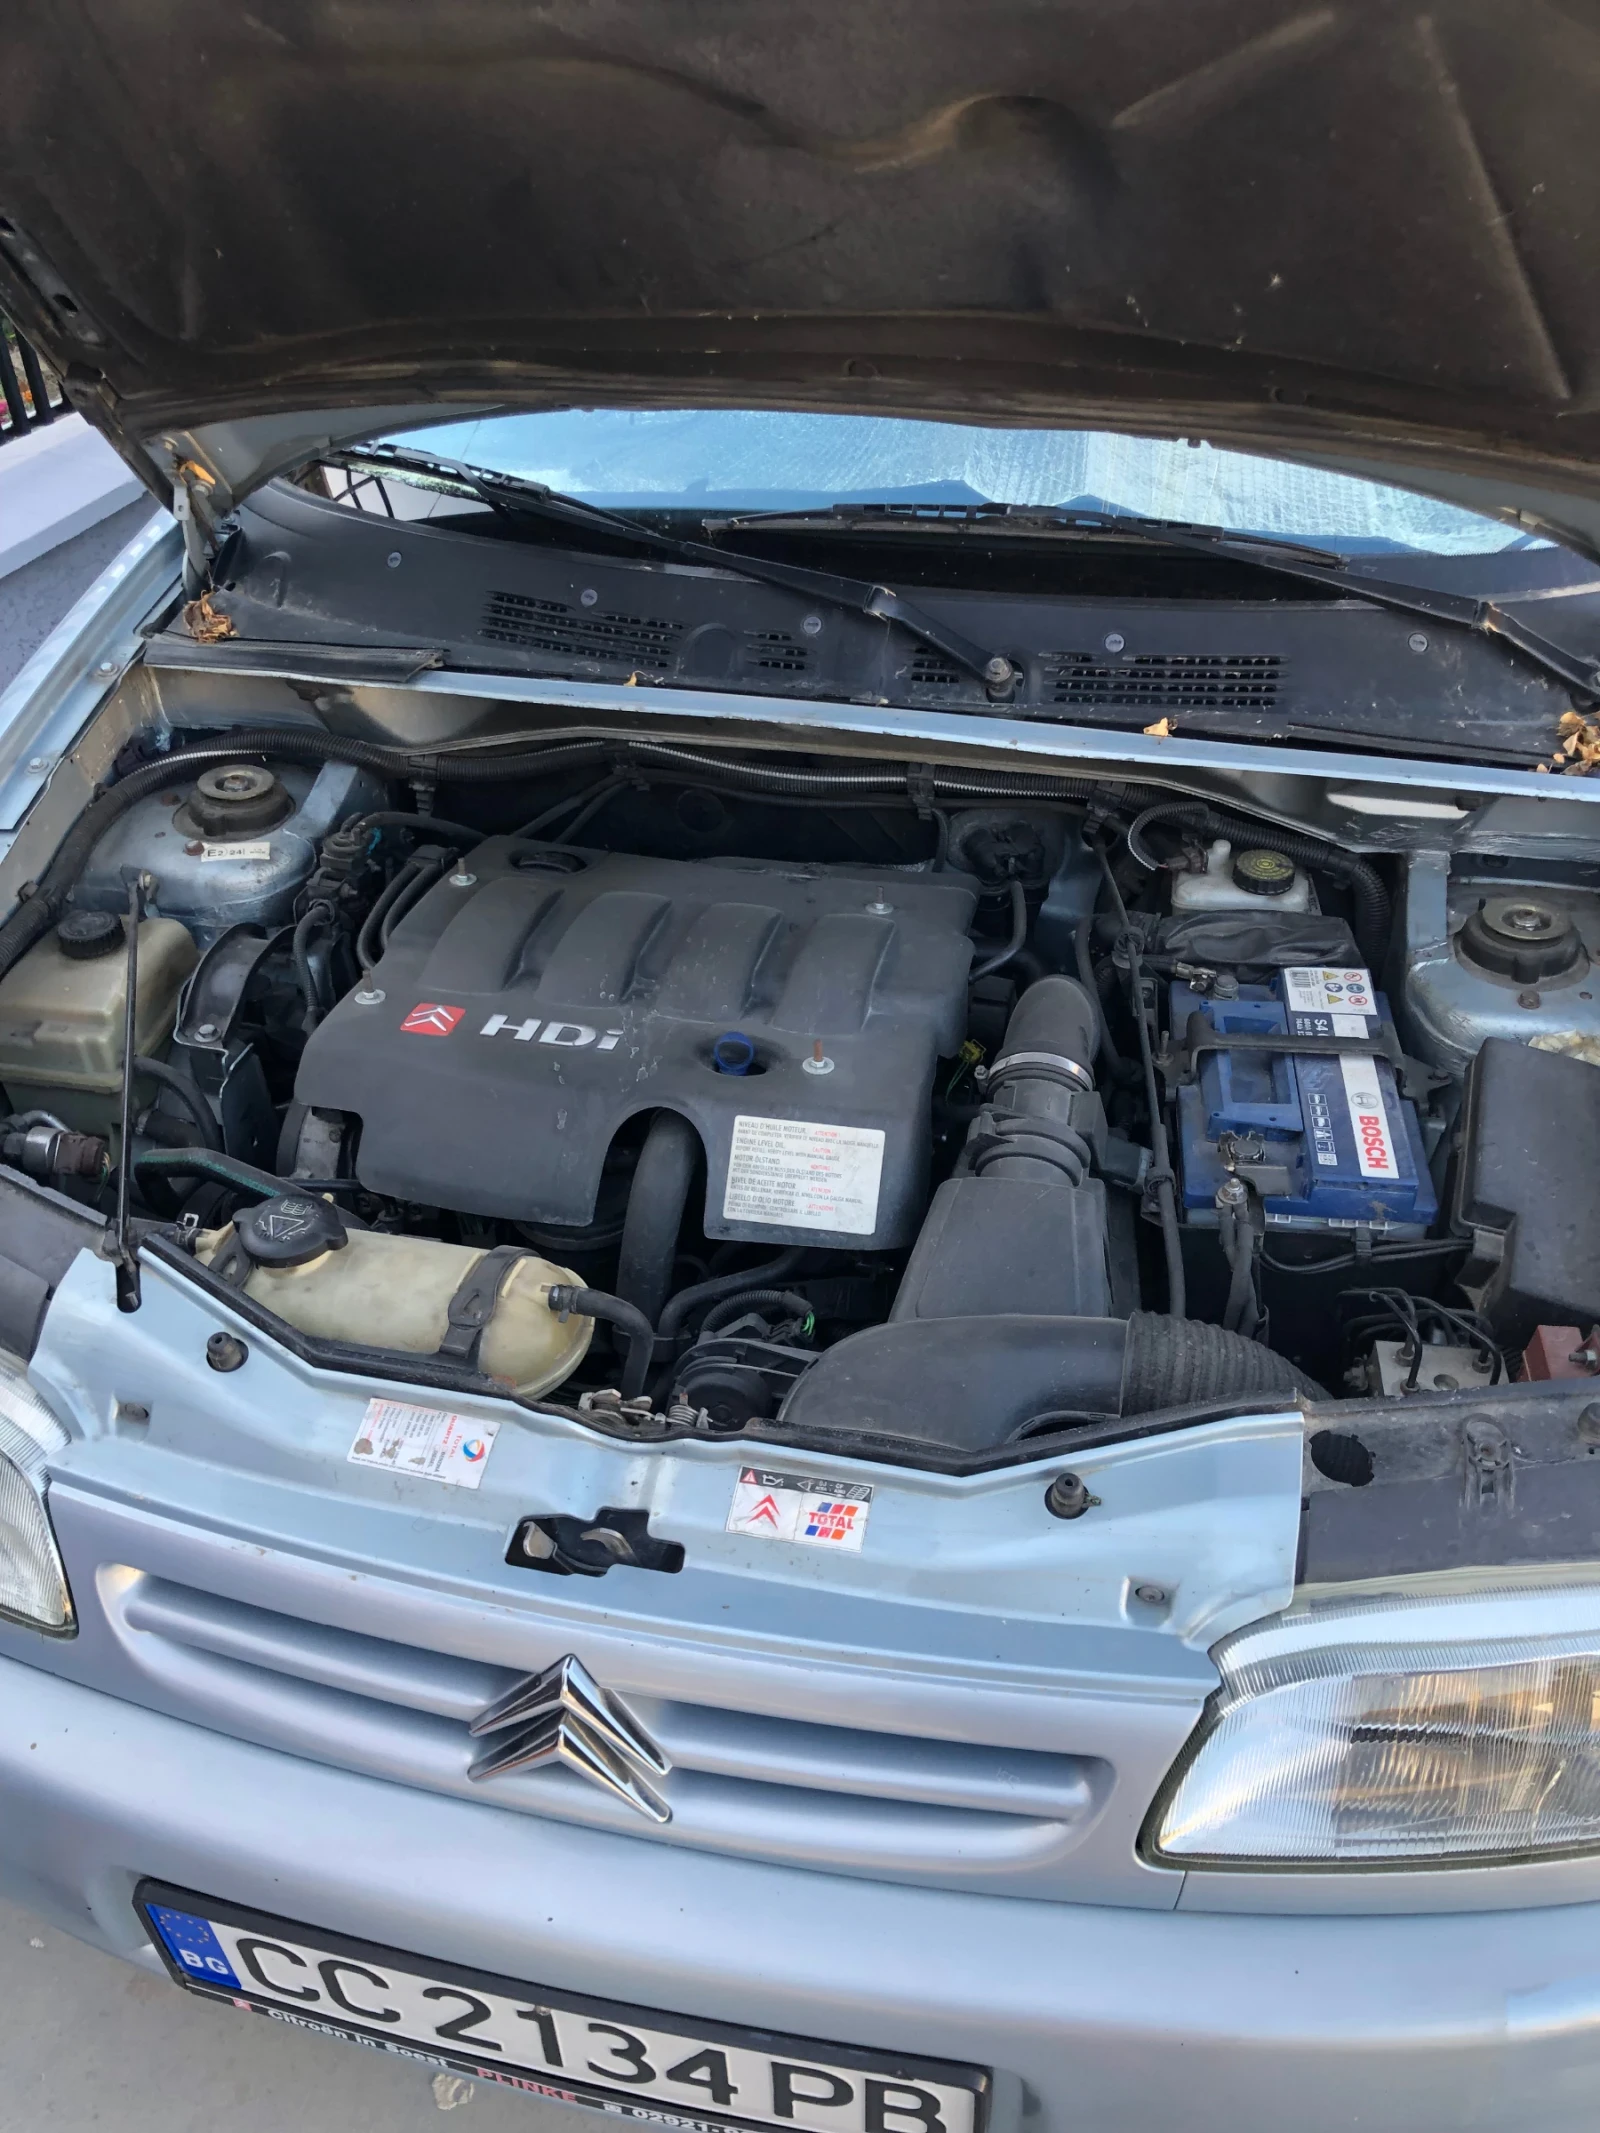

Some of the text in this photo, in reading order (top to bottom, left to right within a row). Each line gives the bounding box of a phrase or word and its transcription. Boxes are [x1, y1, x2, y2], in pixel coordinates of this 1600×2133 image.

[480, 1013, 625, 1050] HDi
[1314, 1018, 1329, 1031] S4
[738, 1121, 759, 1130] NIVEAU
[760, 1122, 782, 1131] D'HUILE
[736, 1137, 757, 1146] ENGINE
[758, 1139, 773, 1147] LEVEL
[1359, 1115, 1389, 1169] BOSCH
[731, 1176, 747, 1184] NIVEL
[757, 1179, 775, 1187] ACEITE
[777, 1181, 796, 1189] MOTOR
[772, 1198, 795, 1206] MOTORE
[442, 1415, 458, 1444] QUARTZ
[448, 1434, 462, 1458] TOTAL
[808, 1512, 854, 1530] TOTAL
[178, 1948, 229, 1976] BG
[236, 1938, 947, 2133] CC 2134 PB
[268, 2009, 348, 2040] Citroën
[384, 2042, 450, 2068] Soest
[477, 2067, 578, 2103] PLINKE
